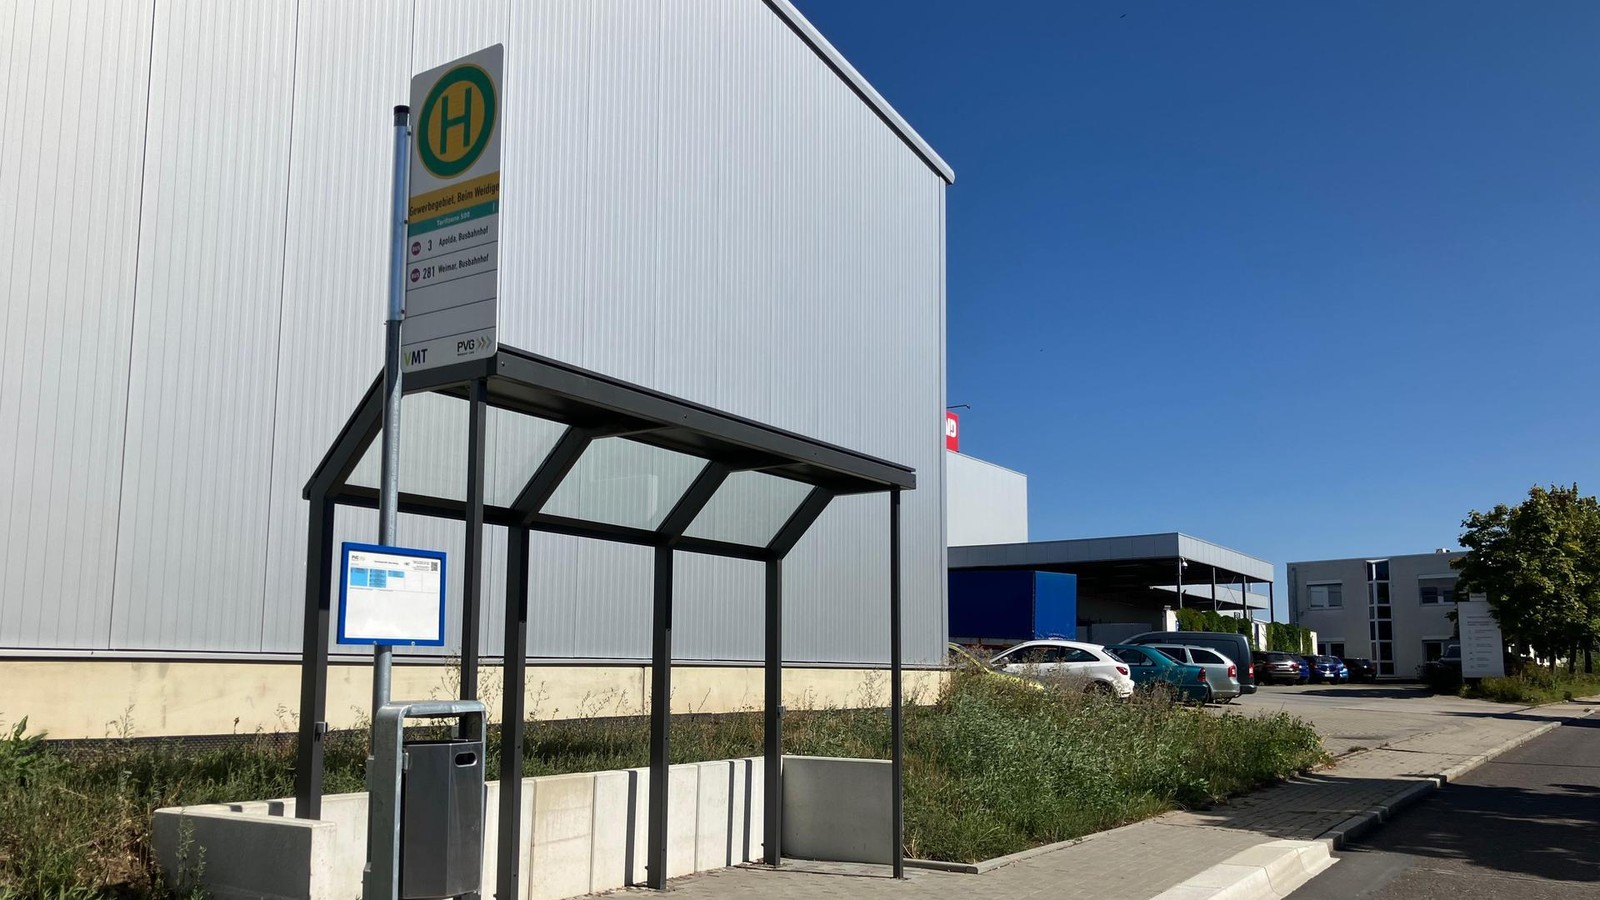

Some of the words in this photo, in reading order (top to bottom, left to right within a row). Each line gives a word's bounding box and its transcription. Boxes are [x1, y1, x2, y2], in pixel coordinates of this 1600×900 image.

[440, 87, 472, 155] H
[457, 190, 473, 202] Beim
[427, 239, 433, 252] 3
[458, 225, 489, 241] Busbahnhof
[422, 265, 435, 280] 281
[458, 253, 489, 269] Busbahnhof
[404, 348, 428, 367] VMT
[457, 339, 475, 353] PVG
